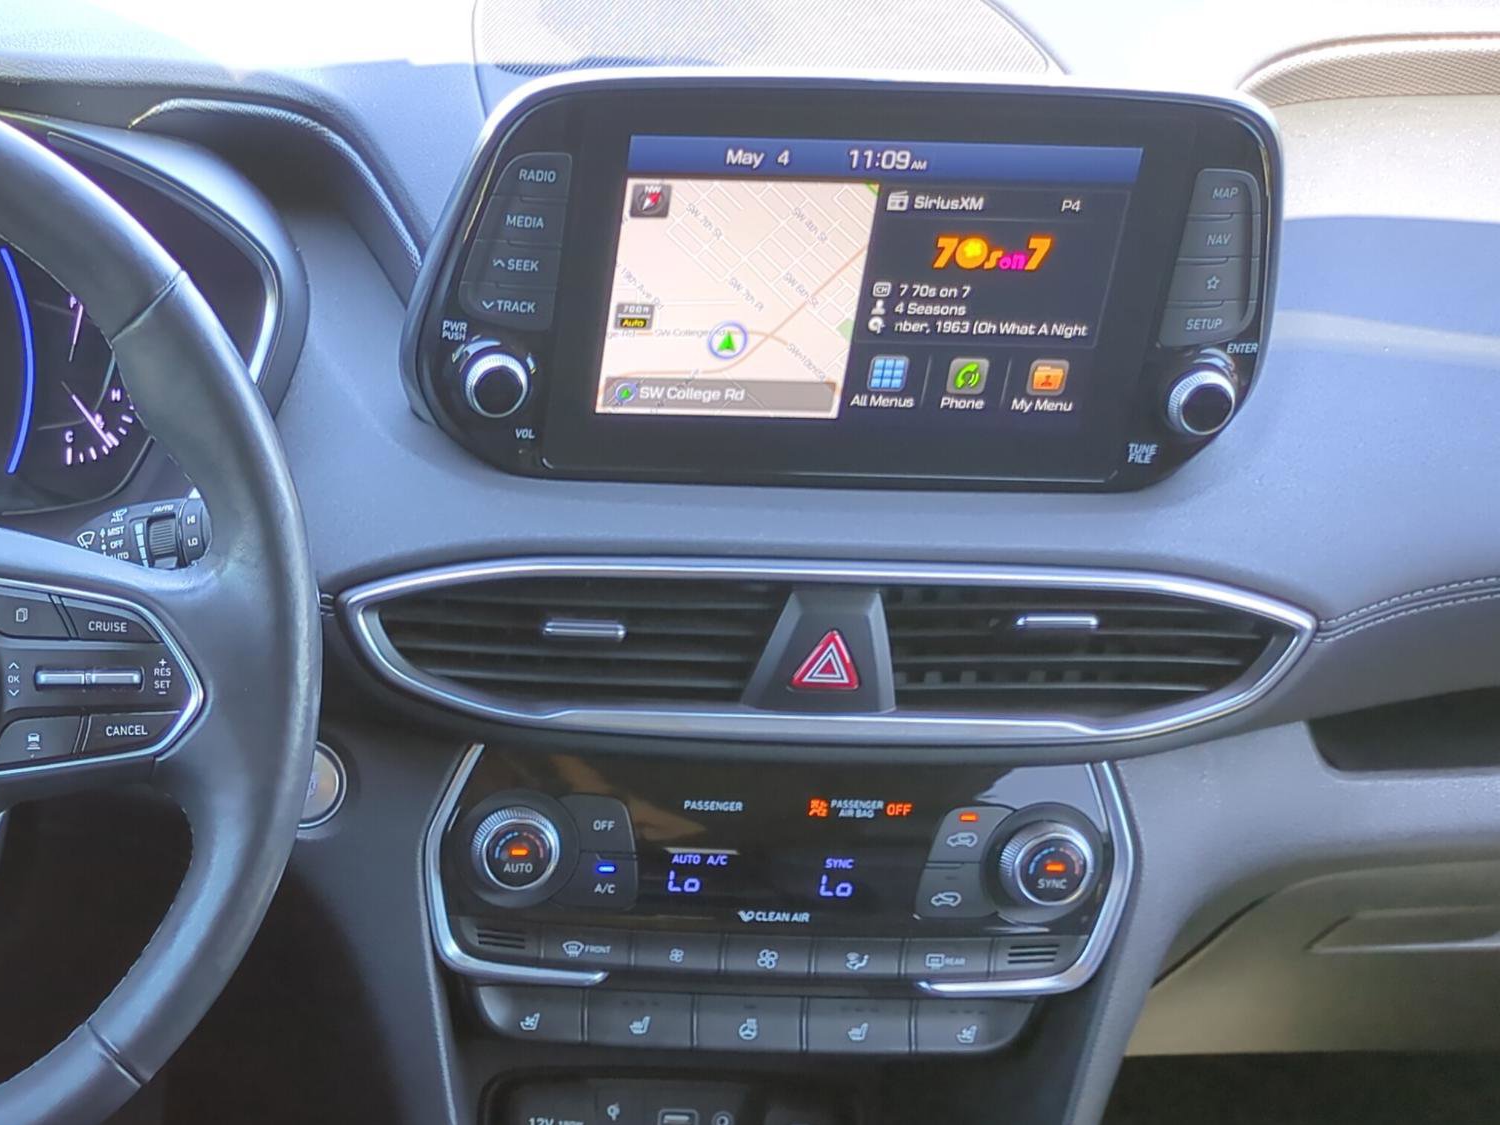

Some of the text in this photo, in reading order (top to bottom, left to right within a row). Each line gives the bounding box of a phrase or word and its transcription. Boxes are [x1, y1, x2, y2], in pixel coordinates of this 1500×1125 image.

[726, 149, 791, 172] May 4
[519, 168, 557, 183] RADIO
[1212, 187, 1238, 199] MAP
[913, 195, 1082, 214] SiriusXM P4
[506, 214, 545, 229] MEDIA
[1207, 233, 1231, 247] NAV
[933, 235, 1052, 270] 70s on 7
[508, 258, 539, 272] SEEK
[899, 285, 971, 298] 7 70s on 7
[497, 299, 536, 315] TRACK
[895, 303, 967, 316] 4 Seasons
[442, 319, 468, 334] PWR
[622, 319, 645, 328] Auto
[936, 321, 968, 333] 1963
[972, 322, 997, 335] (Oh
[999, 322, 1036, 336] What
[1037, 323, 1049, 335] A
[1050, 324, 1088, 339] Night
[1186, 318, 1222, 331] SETUP
[442, 329, 467, 342] PUSH
[1227, 343, 1258, 355] ENTER
[111, 388, 121, 401] H
[640, 386, 746, 403] SW College Rd
[851, 396, 914, 409] All Menus
[940, 397, 985, 411] Phone
[1011, 399, 1073, 413] My Menu
[65, 430, 74, 443] C
[515, 428, 535, 439] VOL
[1128, 443, 1158, 456] TUNE
[1128, 453, 1152, 464] FILE
[186, 515, 196, 525] HI
[107, 526, 125, 536] MIST
[110, 540, 123, 550] OFF
[187, 537, 198, 547] LO
[88, 620, 128, 633] CRUISE
[153, 667, 172, 677] RES
[7, 674, 20, 684] OK
[153, 680, 172, 690] SET
[105, 724, 148, 737] CANCEL
[684, 800, 743, 812] PASSENGER
[830, 799, 884, 811] PASSENGER
[886, 803, 912, 817] OFF
[838, 809, 854, 818] AIR
[593, 820, 615, 832] OFF
[672, 854, 728, 866] AUTO A/C
[825, 858, 854, 869] SYNC
[503, 863, 533, 874] AUTO
[594, 882, 616, 894] A/C
[668, 870, 700, 893] Lo
[819, 875, 853, 898] Lo
[1037, 878, 1068, 889] SYNC
[755, 912, 811, 923] CLEAN AIR
